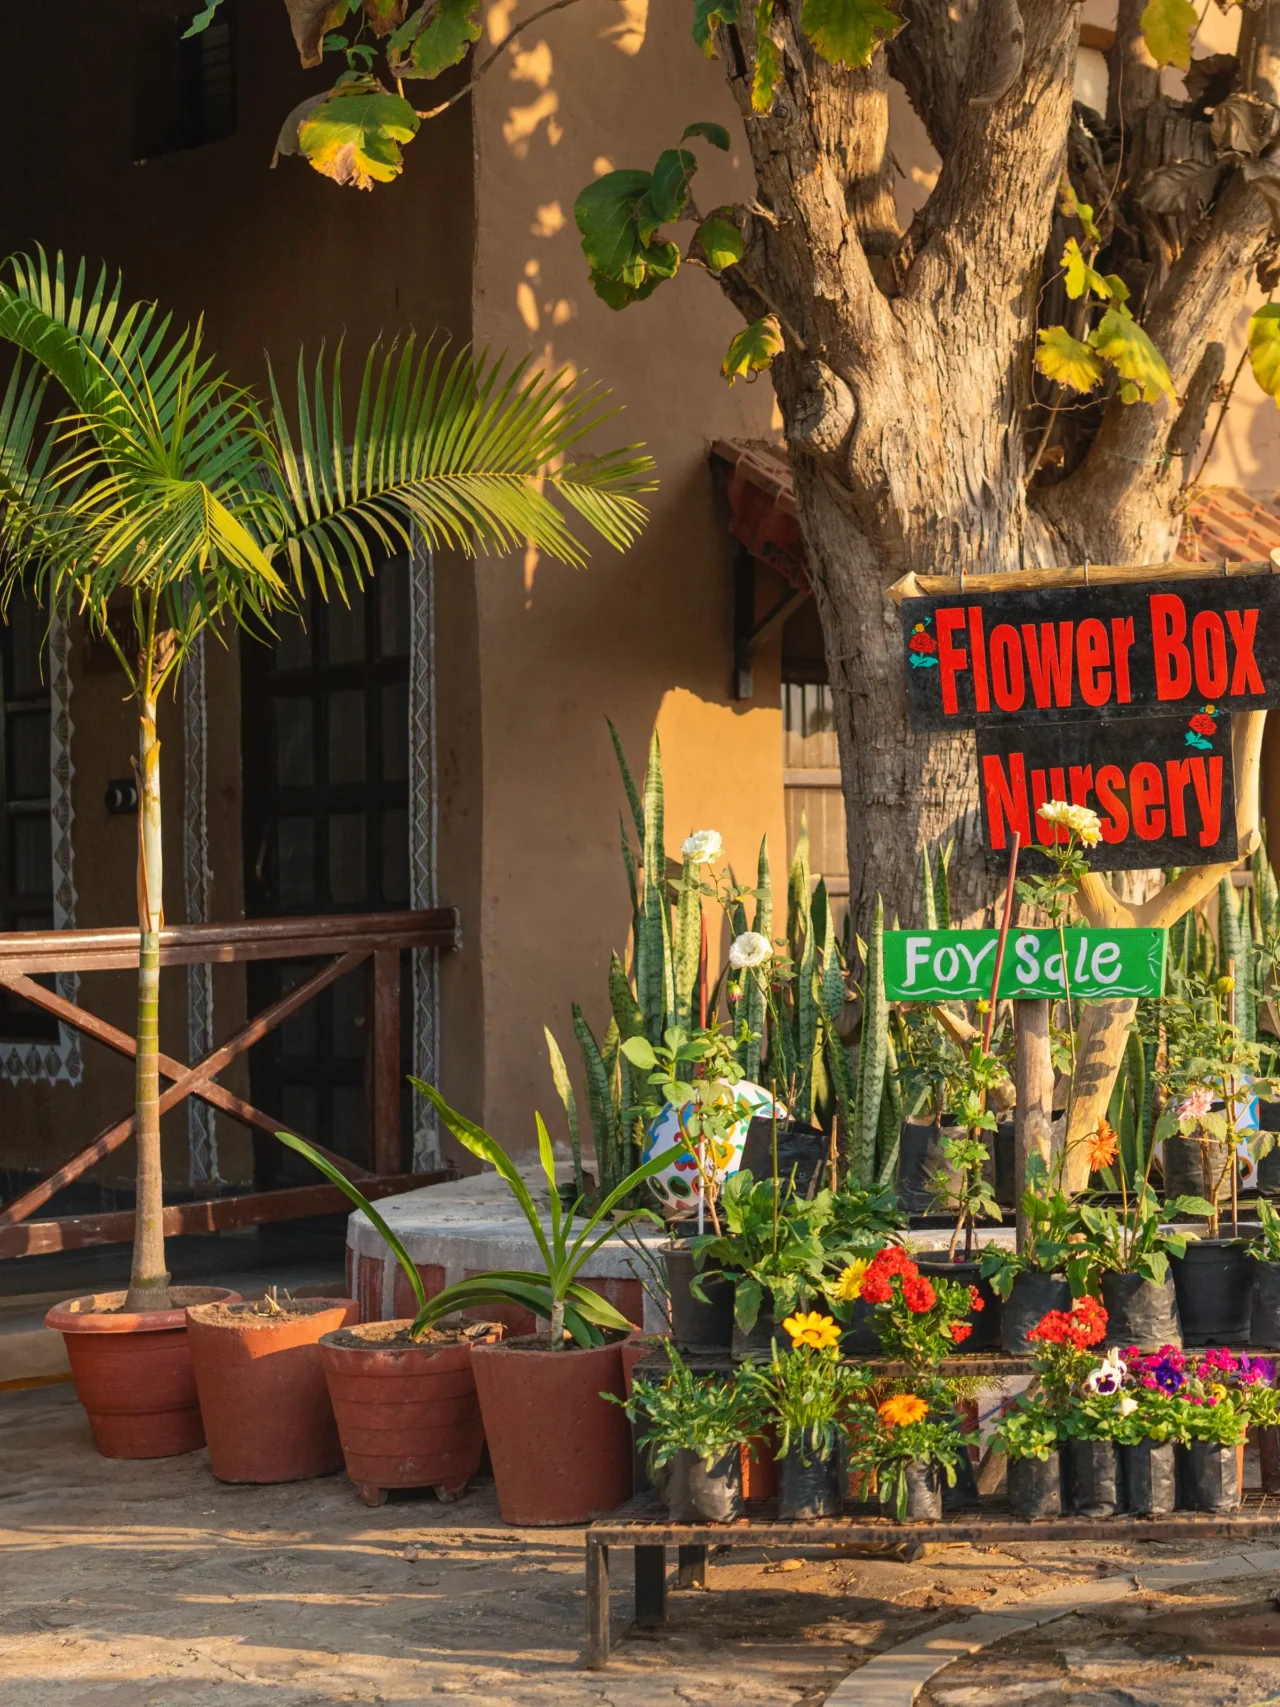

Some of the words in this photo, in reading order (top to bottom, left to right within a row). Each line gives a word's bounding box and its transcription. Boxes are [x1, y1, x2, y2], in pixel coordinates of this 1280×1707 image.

[935, 606, 1135, 714] Flower
[1149, 593, 1266, 701] Box
[983, 752, 1224, 849] Nursery
[1015, 934, 1122, 988] Sale
